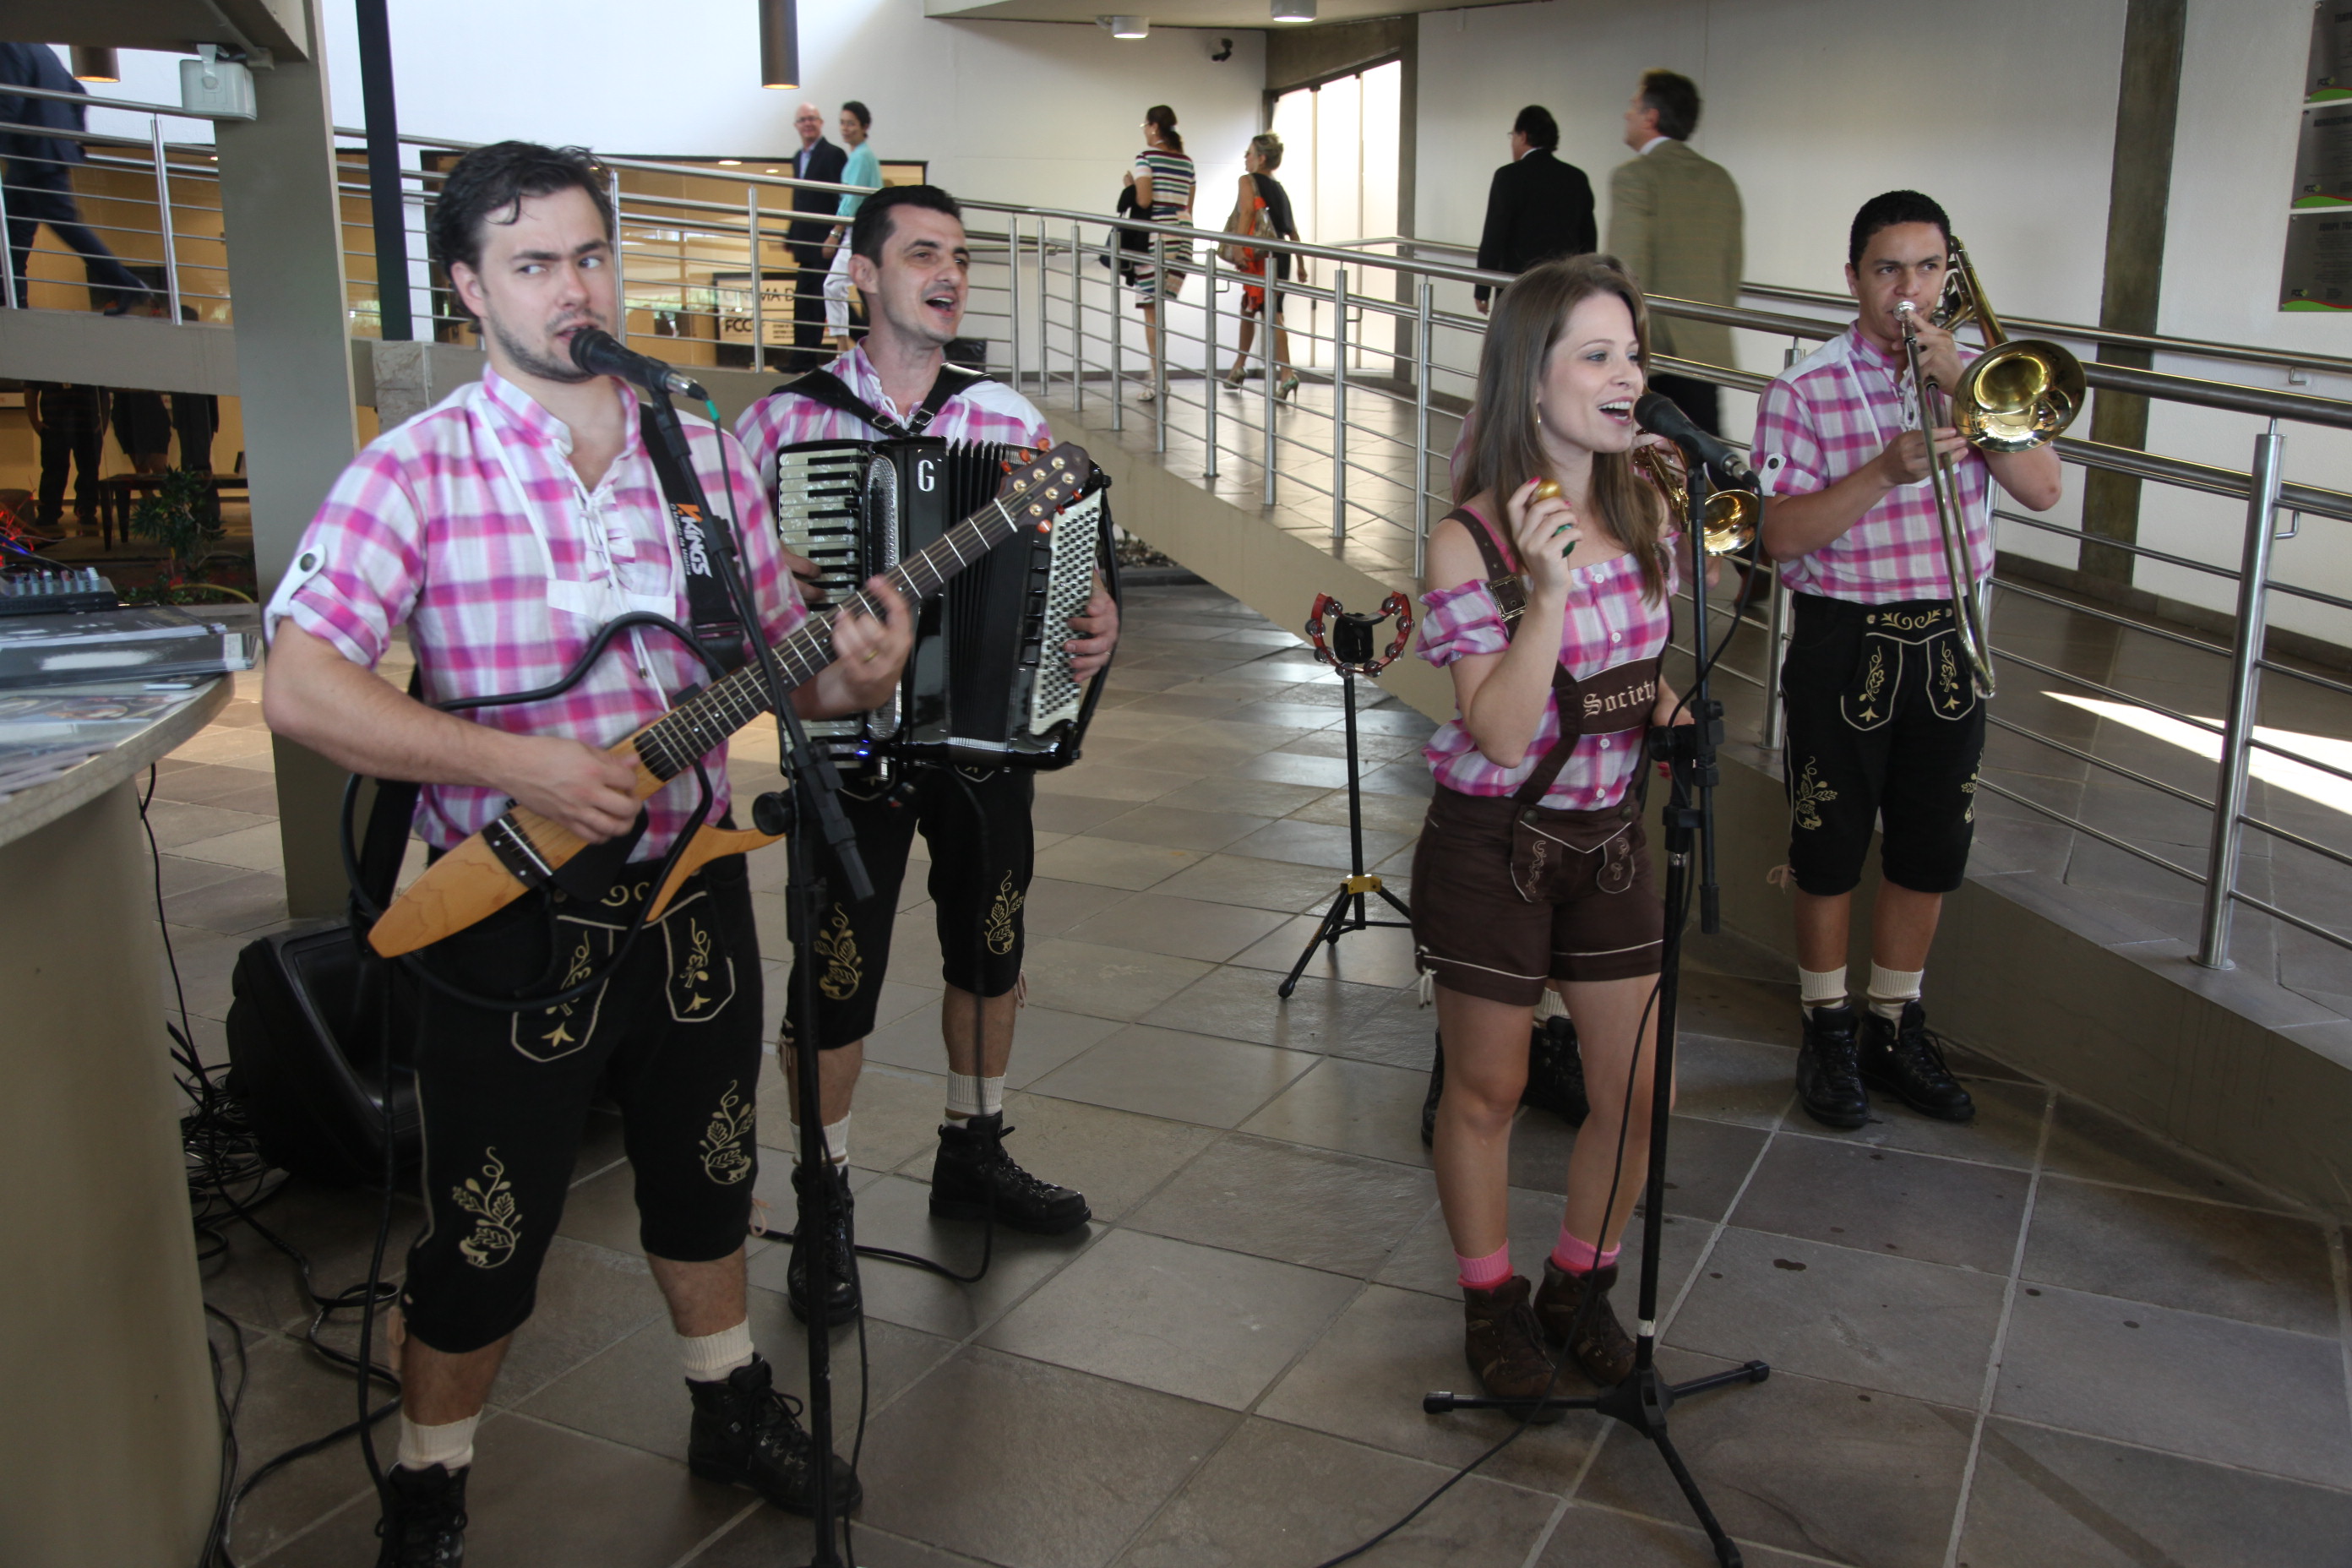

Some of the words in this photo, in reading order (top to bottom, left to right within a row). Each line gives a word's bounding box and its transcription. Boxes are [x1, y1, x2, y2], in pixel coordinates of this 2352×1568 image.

[725, 318, 753, 333] FCC
[917, 460, 935, 493] G
[672, 511, 683, 536] Mundo
[678, 536, 686, 547] da
